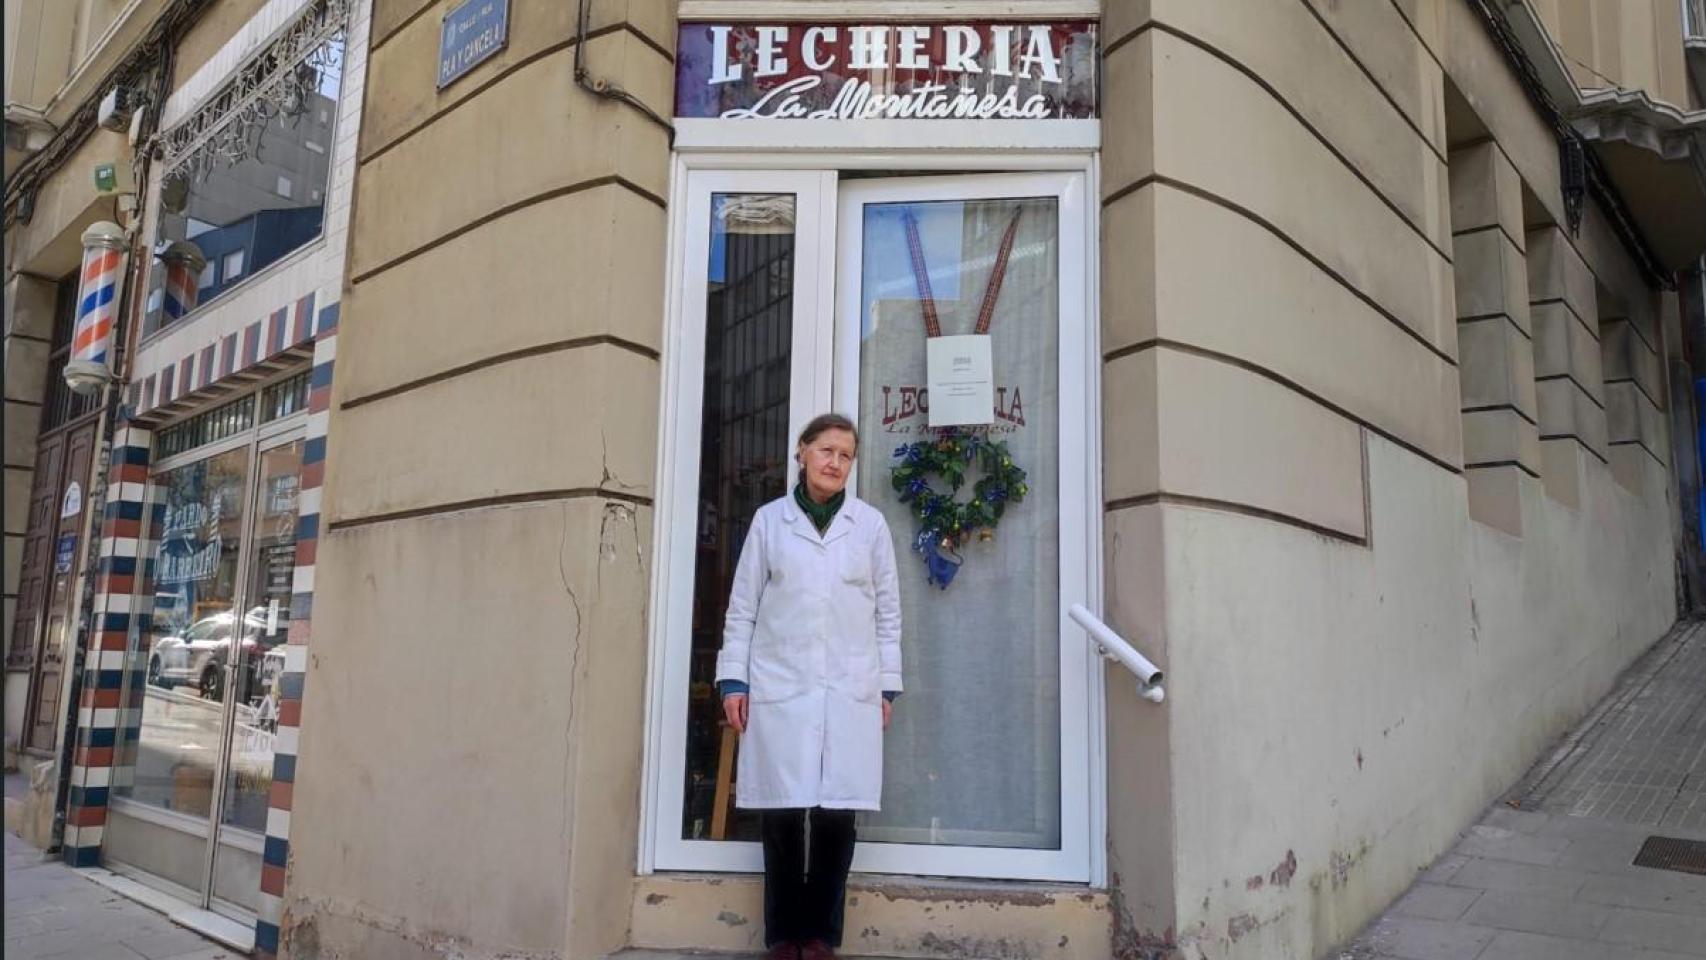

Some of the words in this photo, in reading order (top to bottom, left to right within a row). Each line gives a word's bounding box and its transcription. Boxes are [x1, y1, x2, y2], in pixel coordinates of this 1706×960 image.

[708, 24, 1062, 85] LECHERIA
[721, 75, 821, 119] La
[807, 76, 1051, 120] Montañesa
[881, 385, 1026, 426] LECIA
